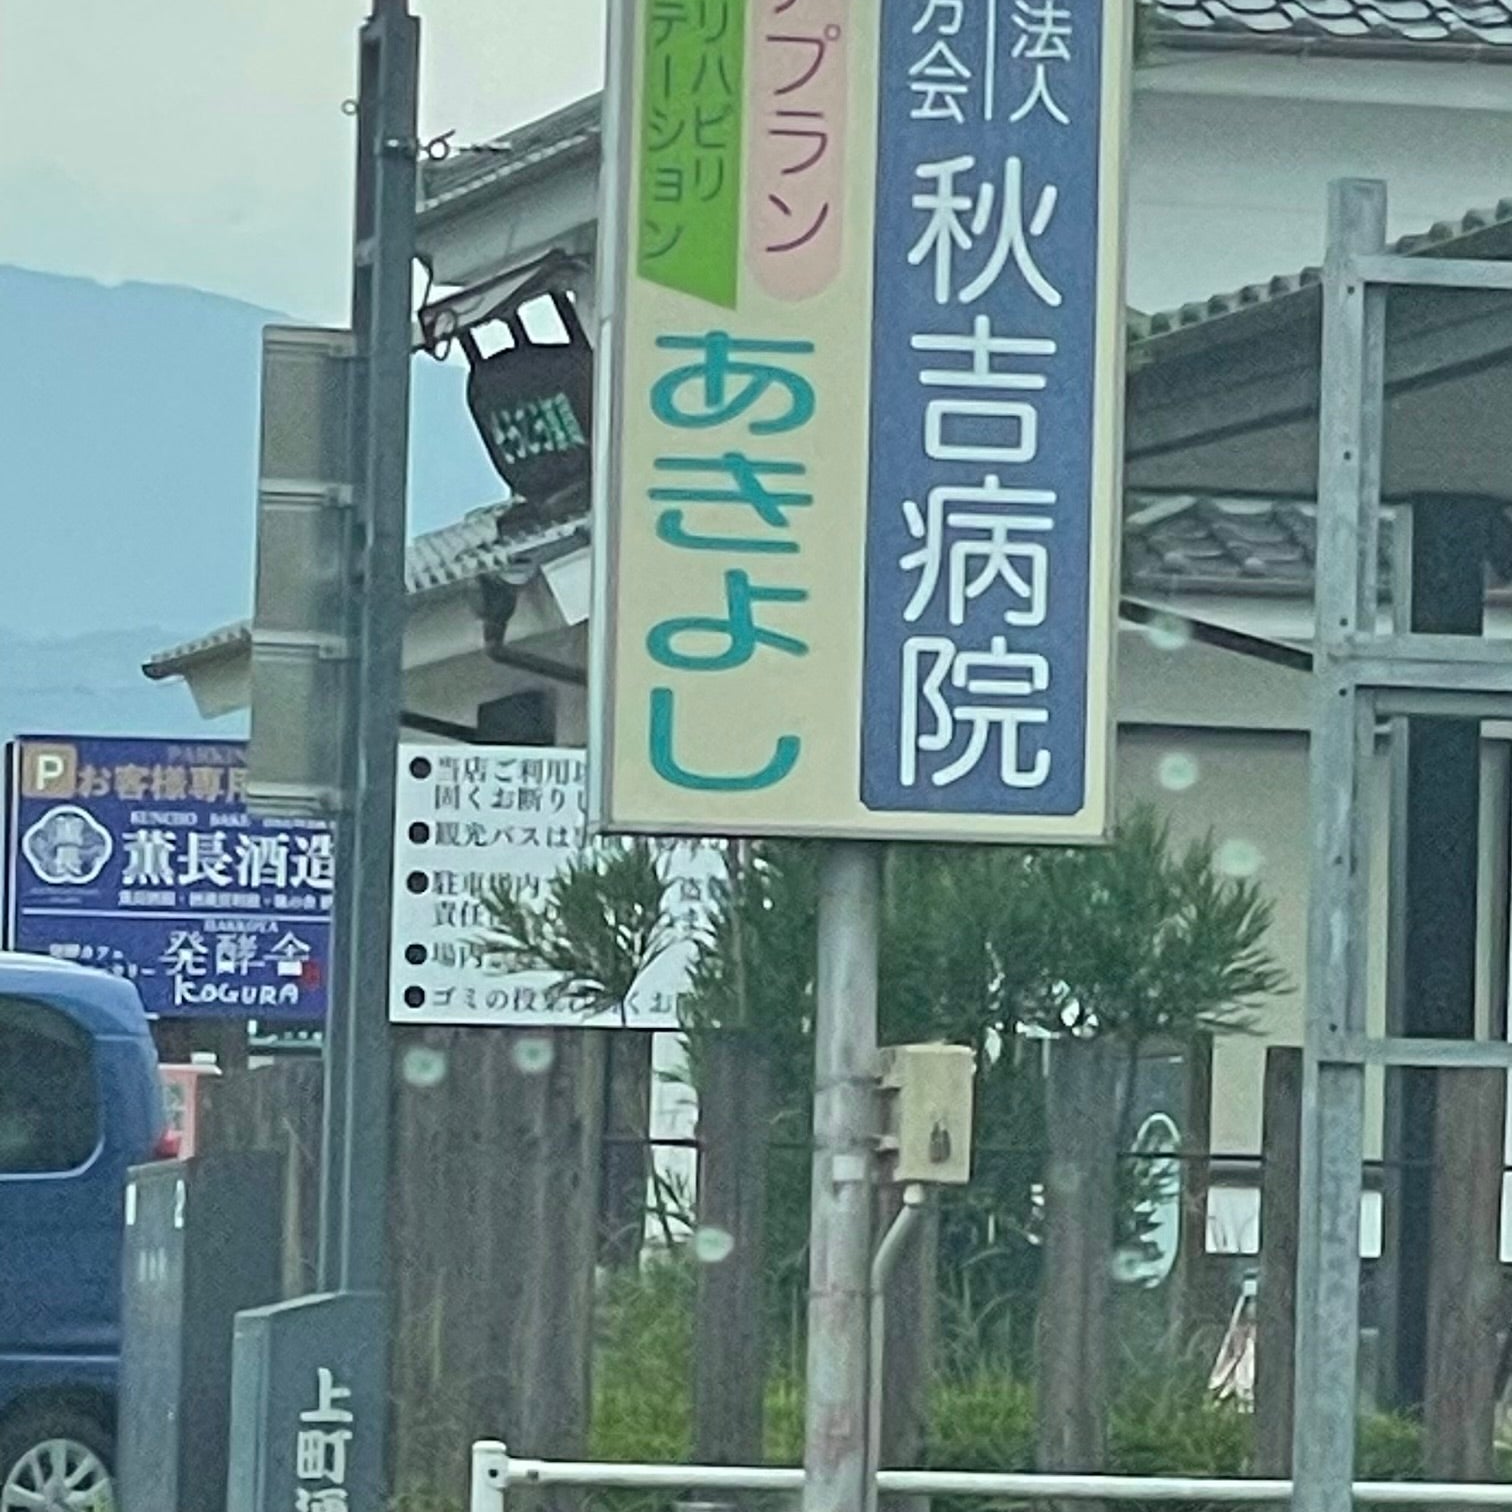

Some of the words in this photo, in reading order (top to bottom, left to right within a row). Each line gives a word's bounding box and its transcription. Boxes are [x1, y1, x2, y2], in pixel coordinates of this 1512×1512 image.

[643, 0, 688, 261] テーション
[690, 0, 735, 203] リハビリ
[646, 330, 816, 792] あきよし
[899, 156, 1063, 788] 秋吉病院
[36, 755, 64, 791] P
[174, 974, 299, 1006] KOGURA
